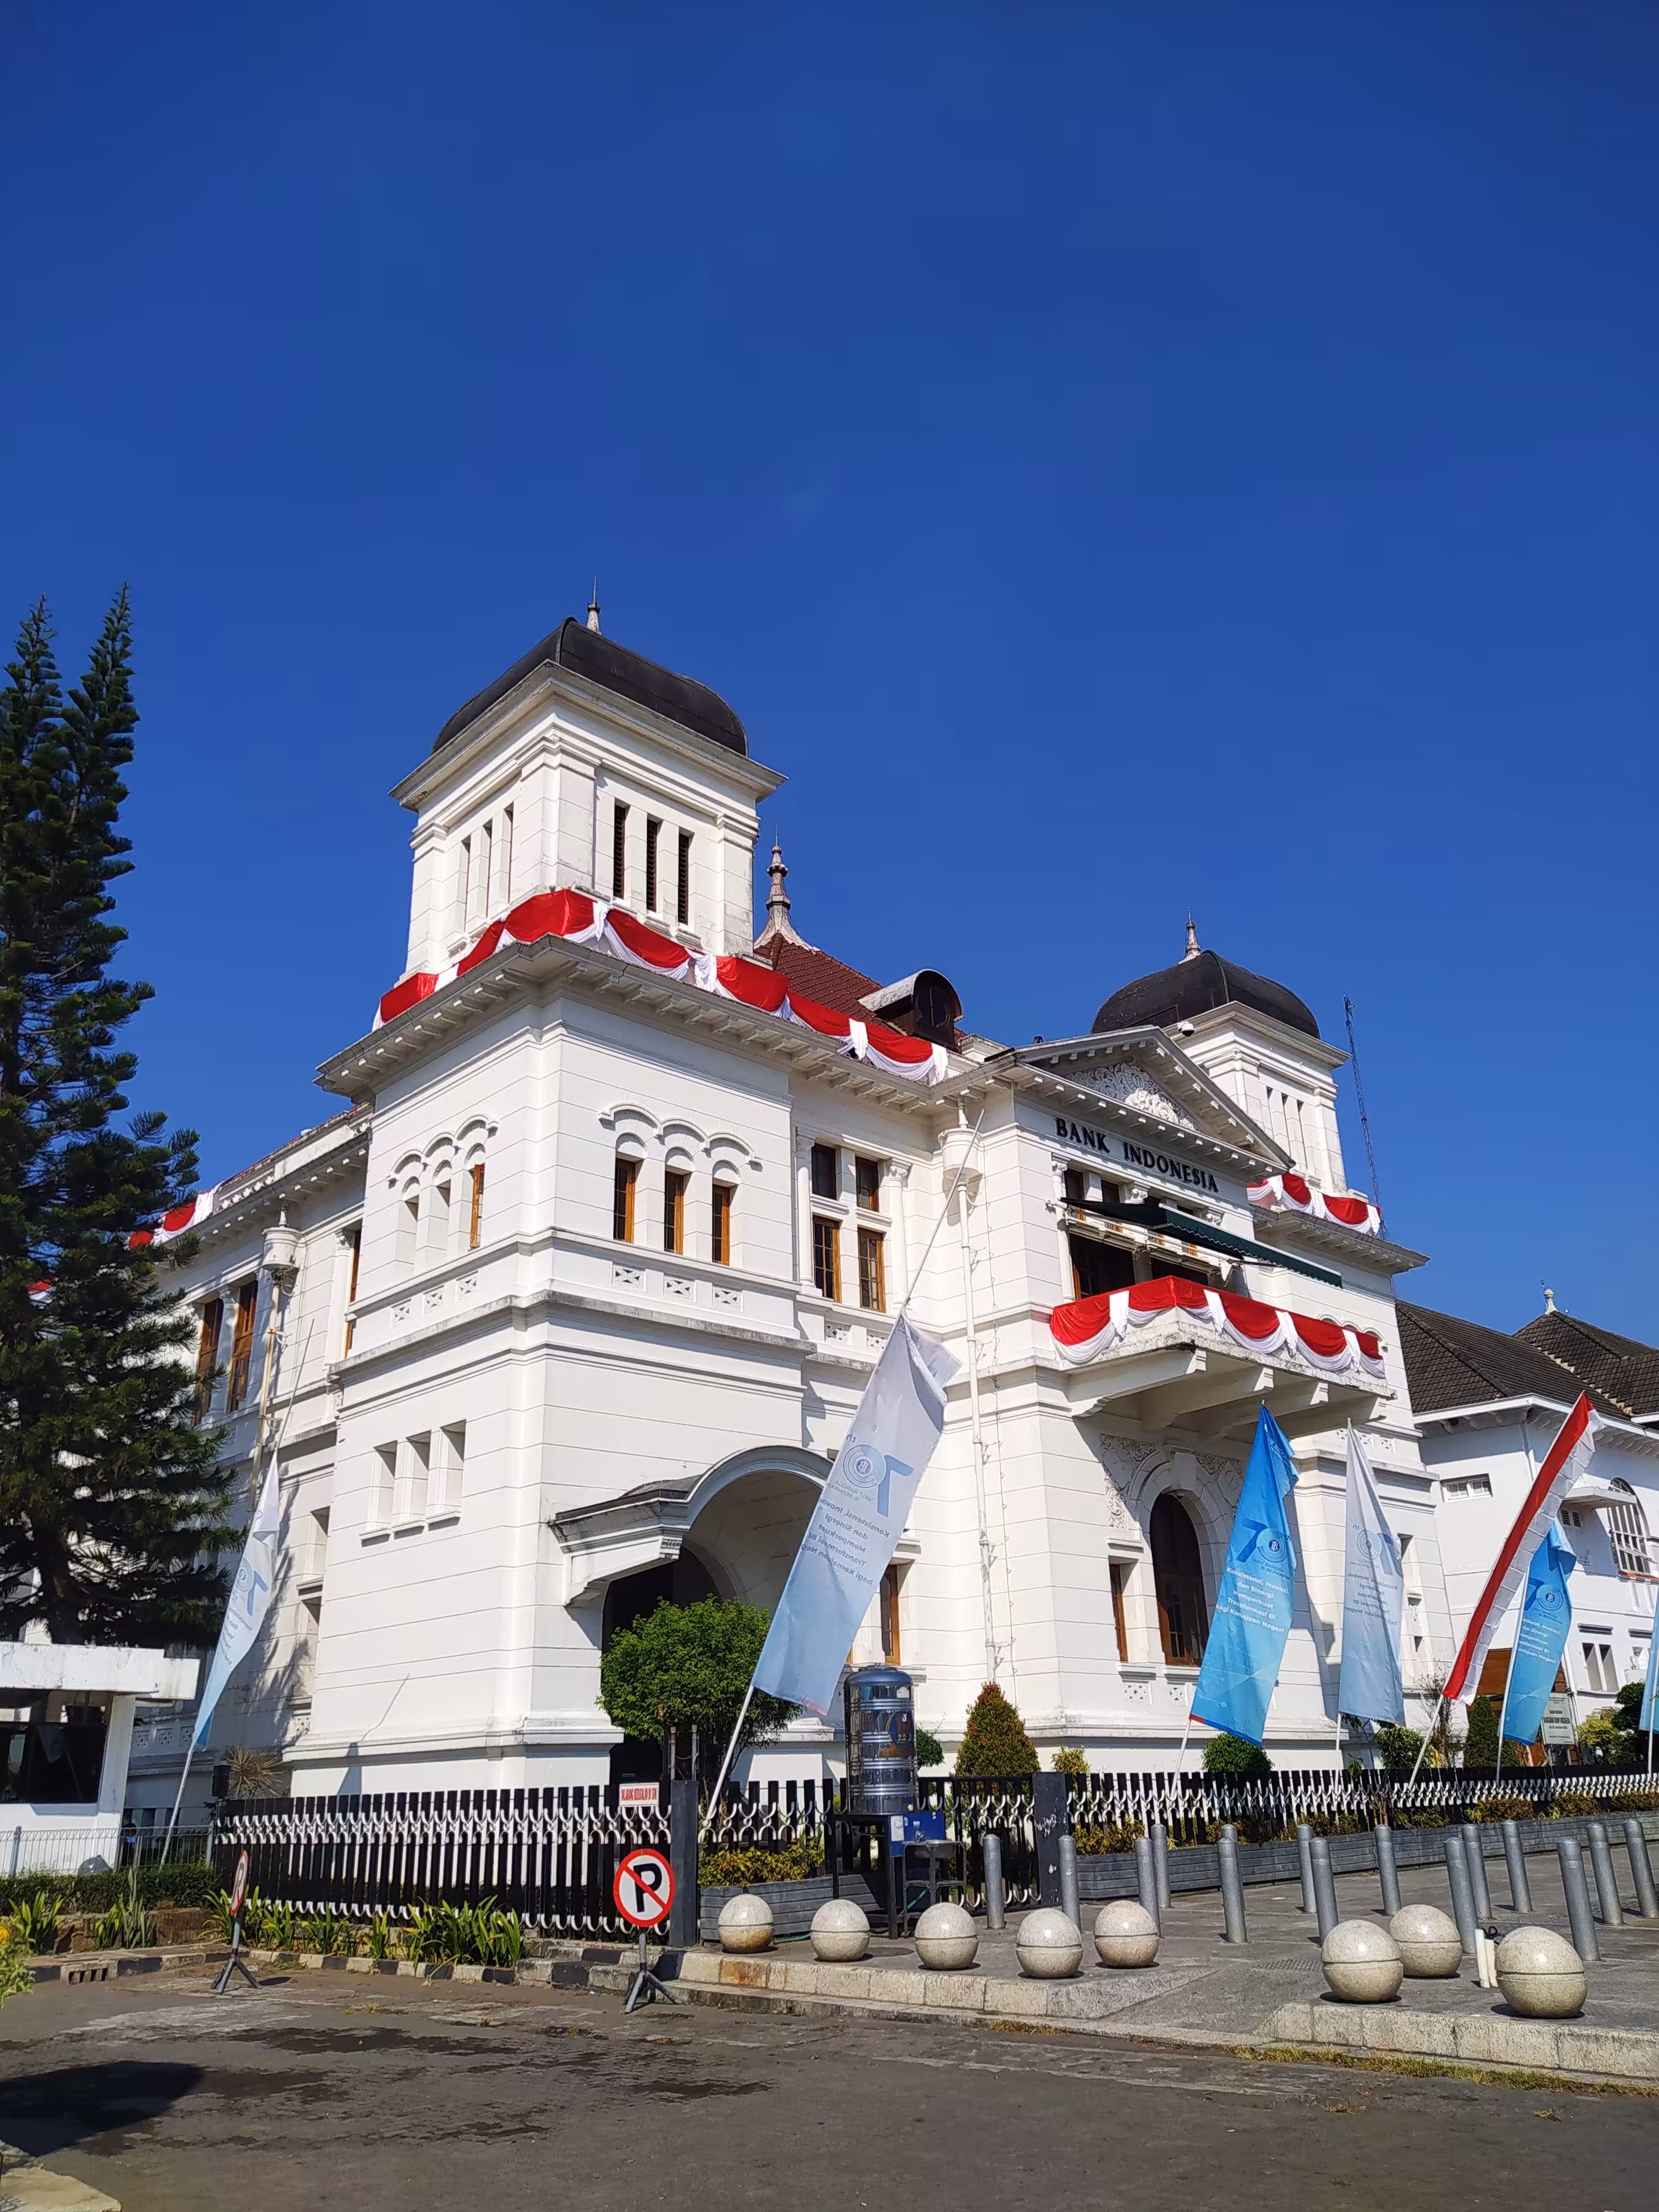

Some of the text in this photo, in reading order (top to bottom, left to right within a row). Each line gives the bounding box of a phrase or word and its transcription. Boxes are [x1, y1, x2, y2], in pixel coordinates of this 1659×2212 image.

[1055, 1117, 1219, 1193] BANK INDONESIA
[1226, 1567, 1290, 1595] Konsistensi, Inovasi,
[1237, 1581, 1275, 1599] dan Sinergi
[1228, 1597, 1267, 1616] Transformasi
[1233, 1590, 1274, 1609] Memperkuat
[1215, 1603, 1285, 1634] bagi Kemajuan Negeri
[1531, 1629, 1549, 1638] Sinergi
[1538, 1654, 1556, 1664] Negeri
